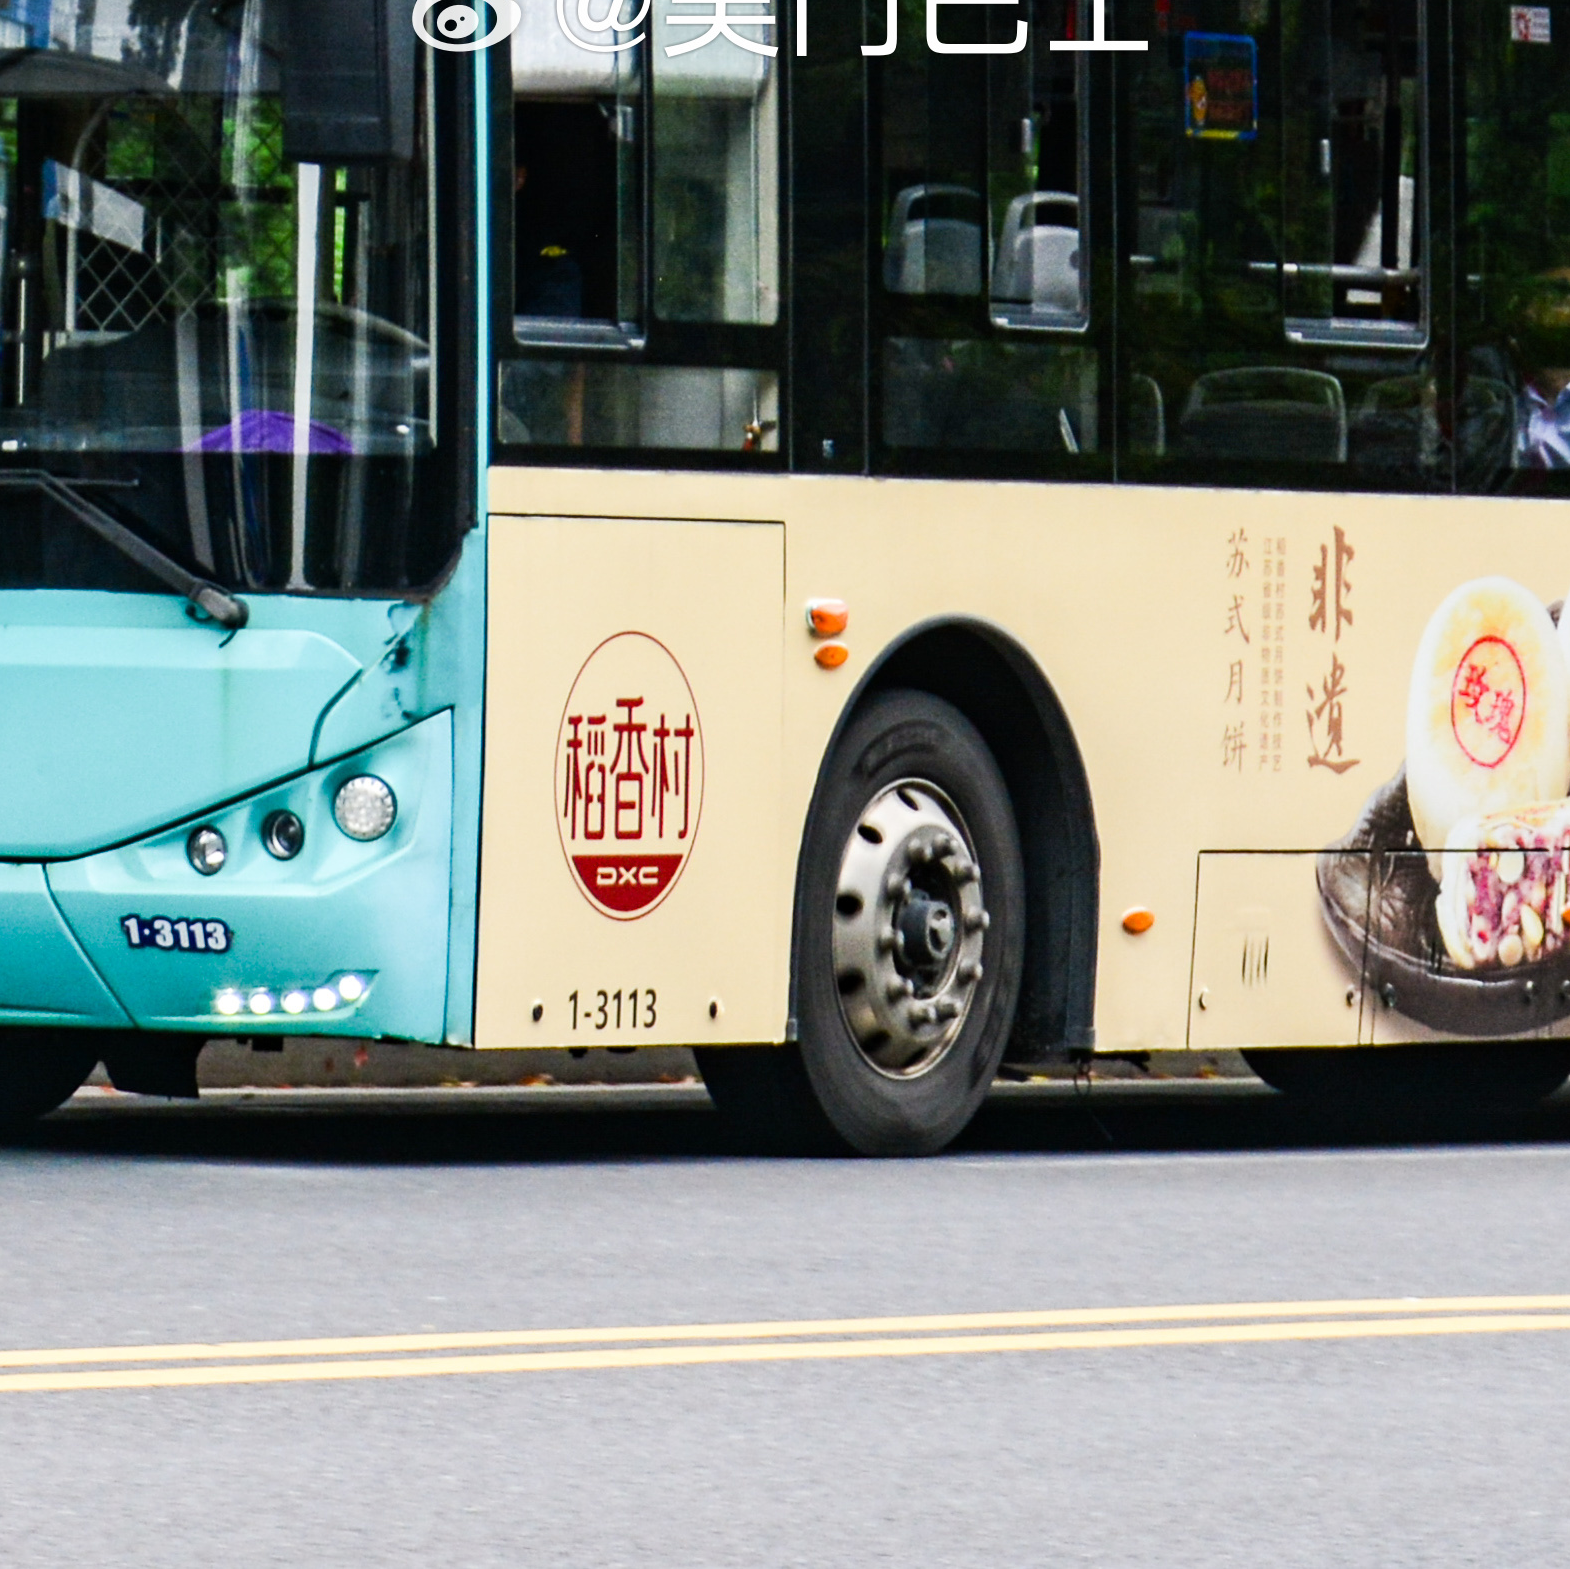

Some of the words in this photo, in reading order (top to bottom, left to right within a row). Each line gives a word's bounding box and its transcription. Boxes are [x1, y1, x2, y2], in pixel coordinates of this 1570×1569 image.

[1221, 526, 1251, 774] 苏式月饼
[564, 696, 695, 840] 稻香村
[596, 866, 659, 886] DXC
[568, 988, 658, 1031] 1-3113
